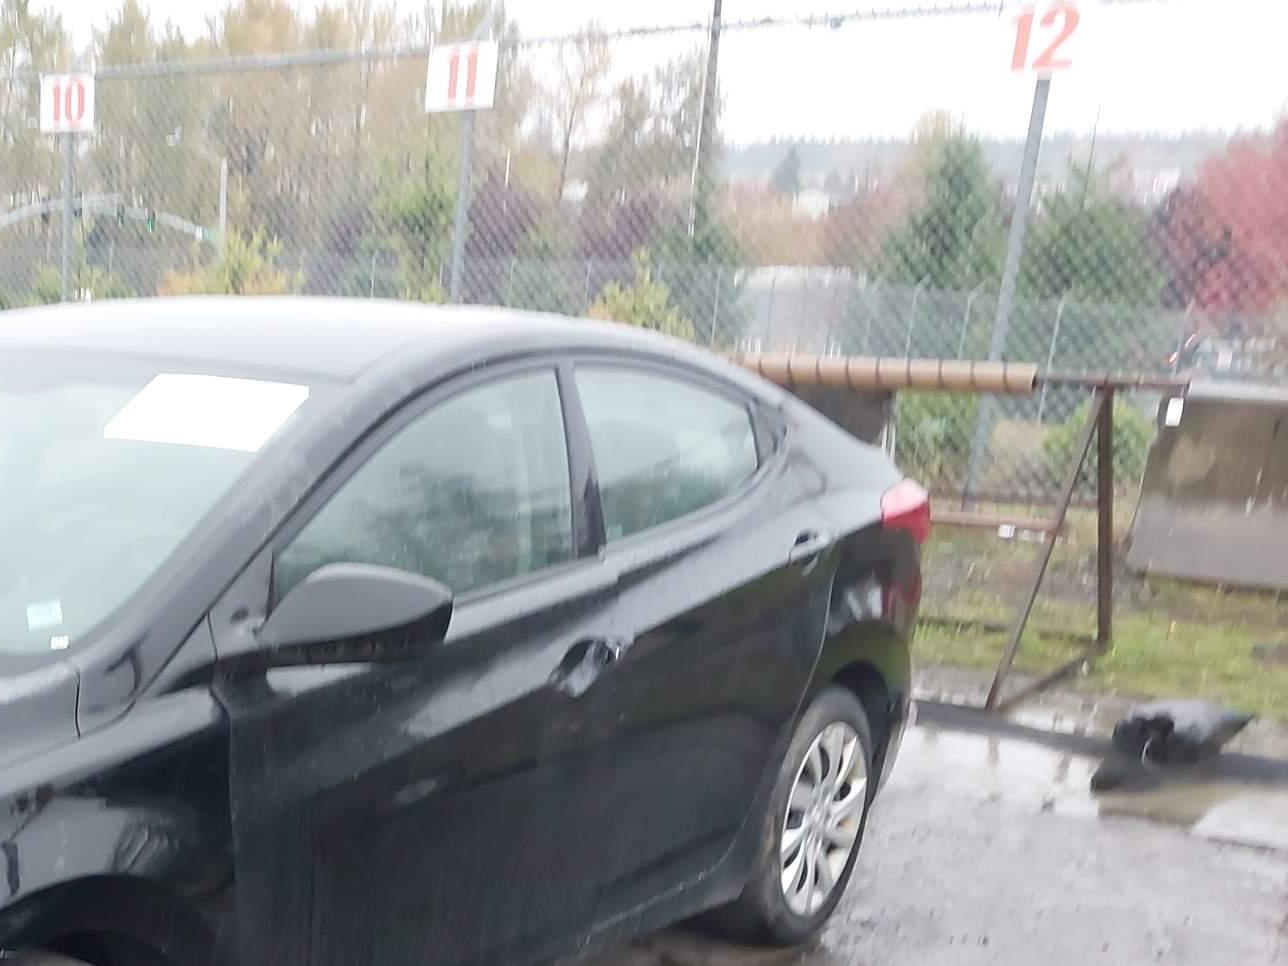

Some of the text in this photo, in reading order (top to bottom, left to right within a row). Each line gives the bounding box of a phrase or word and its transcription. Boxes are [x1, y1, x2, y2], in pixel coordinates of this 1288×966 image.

[1011, 2, 1081, 72] 12
[52, 75, 86, 130] 10
[446, 46, 479, 105] 11
